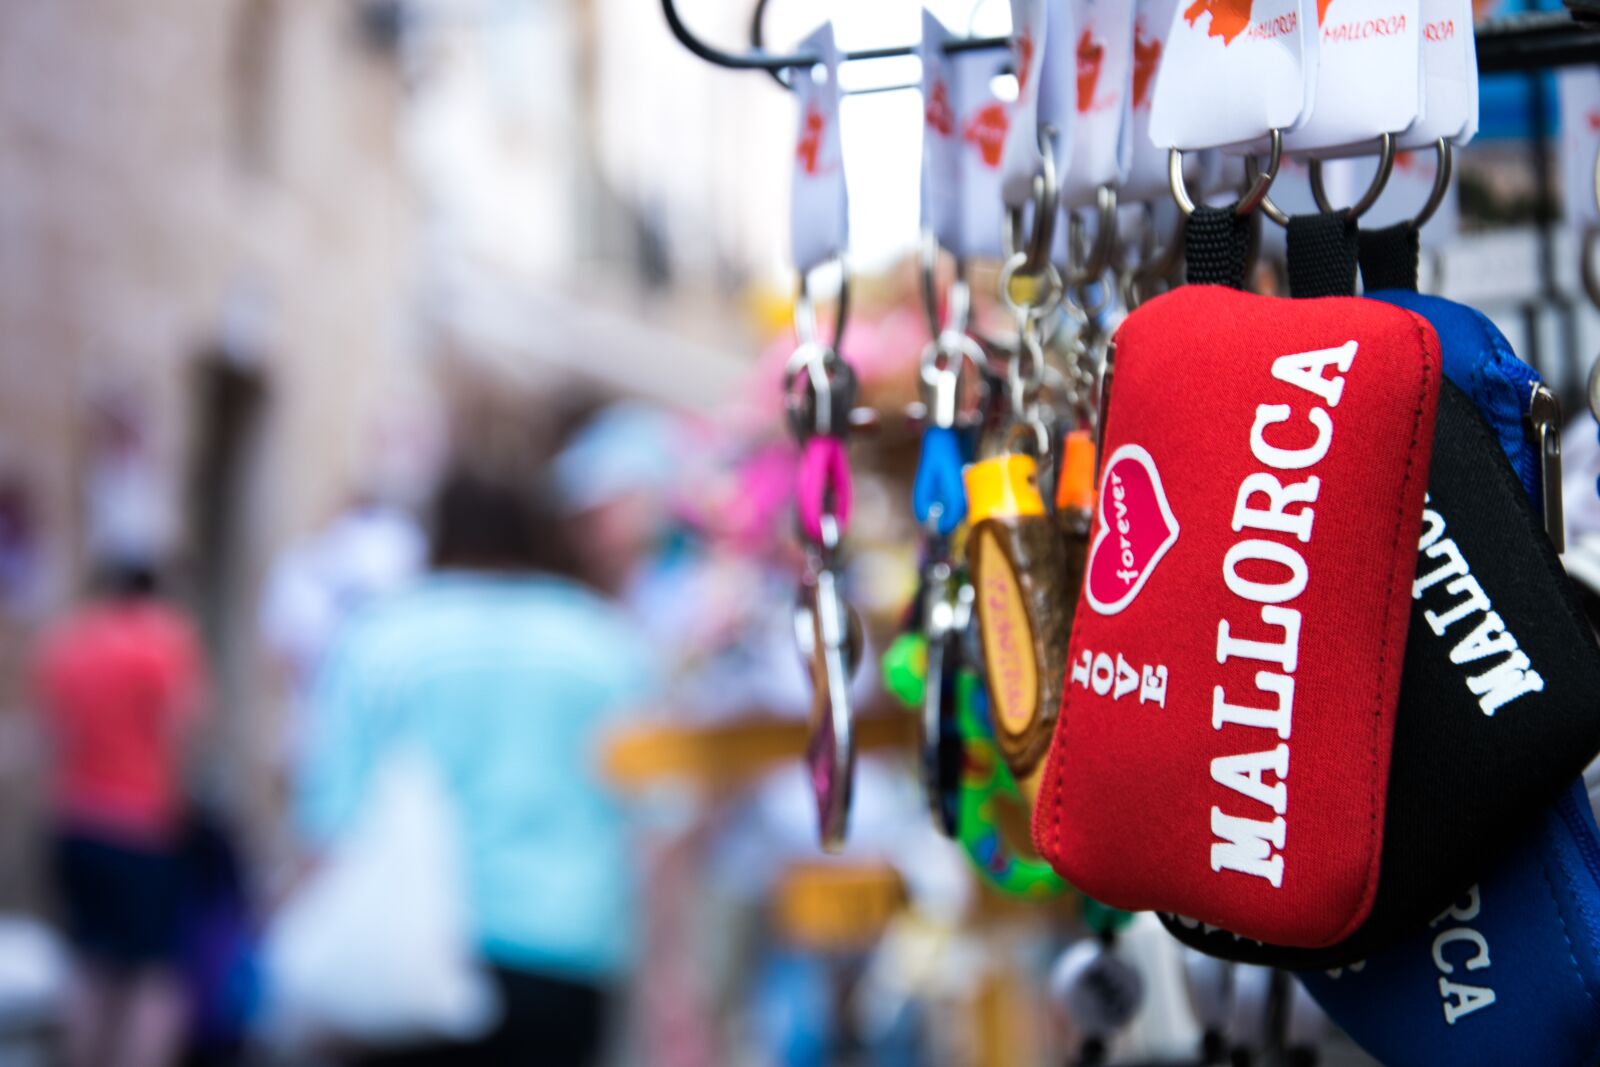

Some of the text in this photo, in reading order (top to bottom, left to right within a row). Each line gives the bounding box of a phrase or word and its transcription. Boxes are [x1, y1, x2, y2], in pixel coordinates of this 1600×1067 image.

[1322, 15, 1406, 44] MALLORCA
[1422, 19, 1454, 42] RCA
[1111, 472, 1140, 585] forever
[1210, 339, 1358, 888] MALLORCA
[1412, 492, 1545, 717] MALL
[1071, 649, 1168, 709] LOVE
